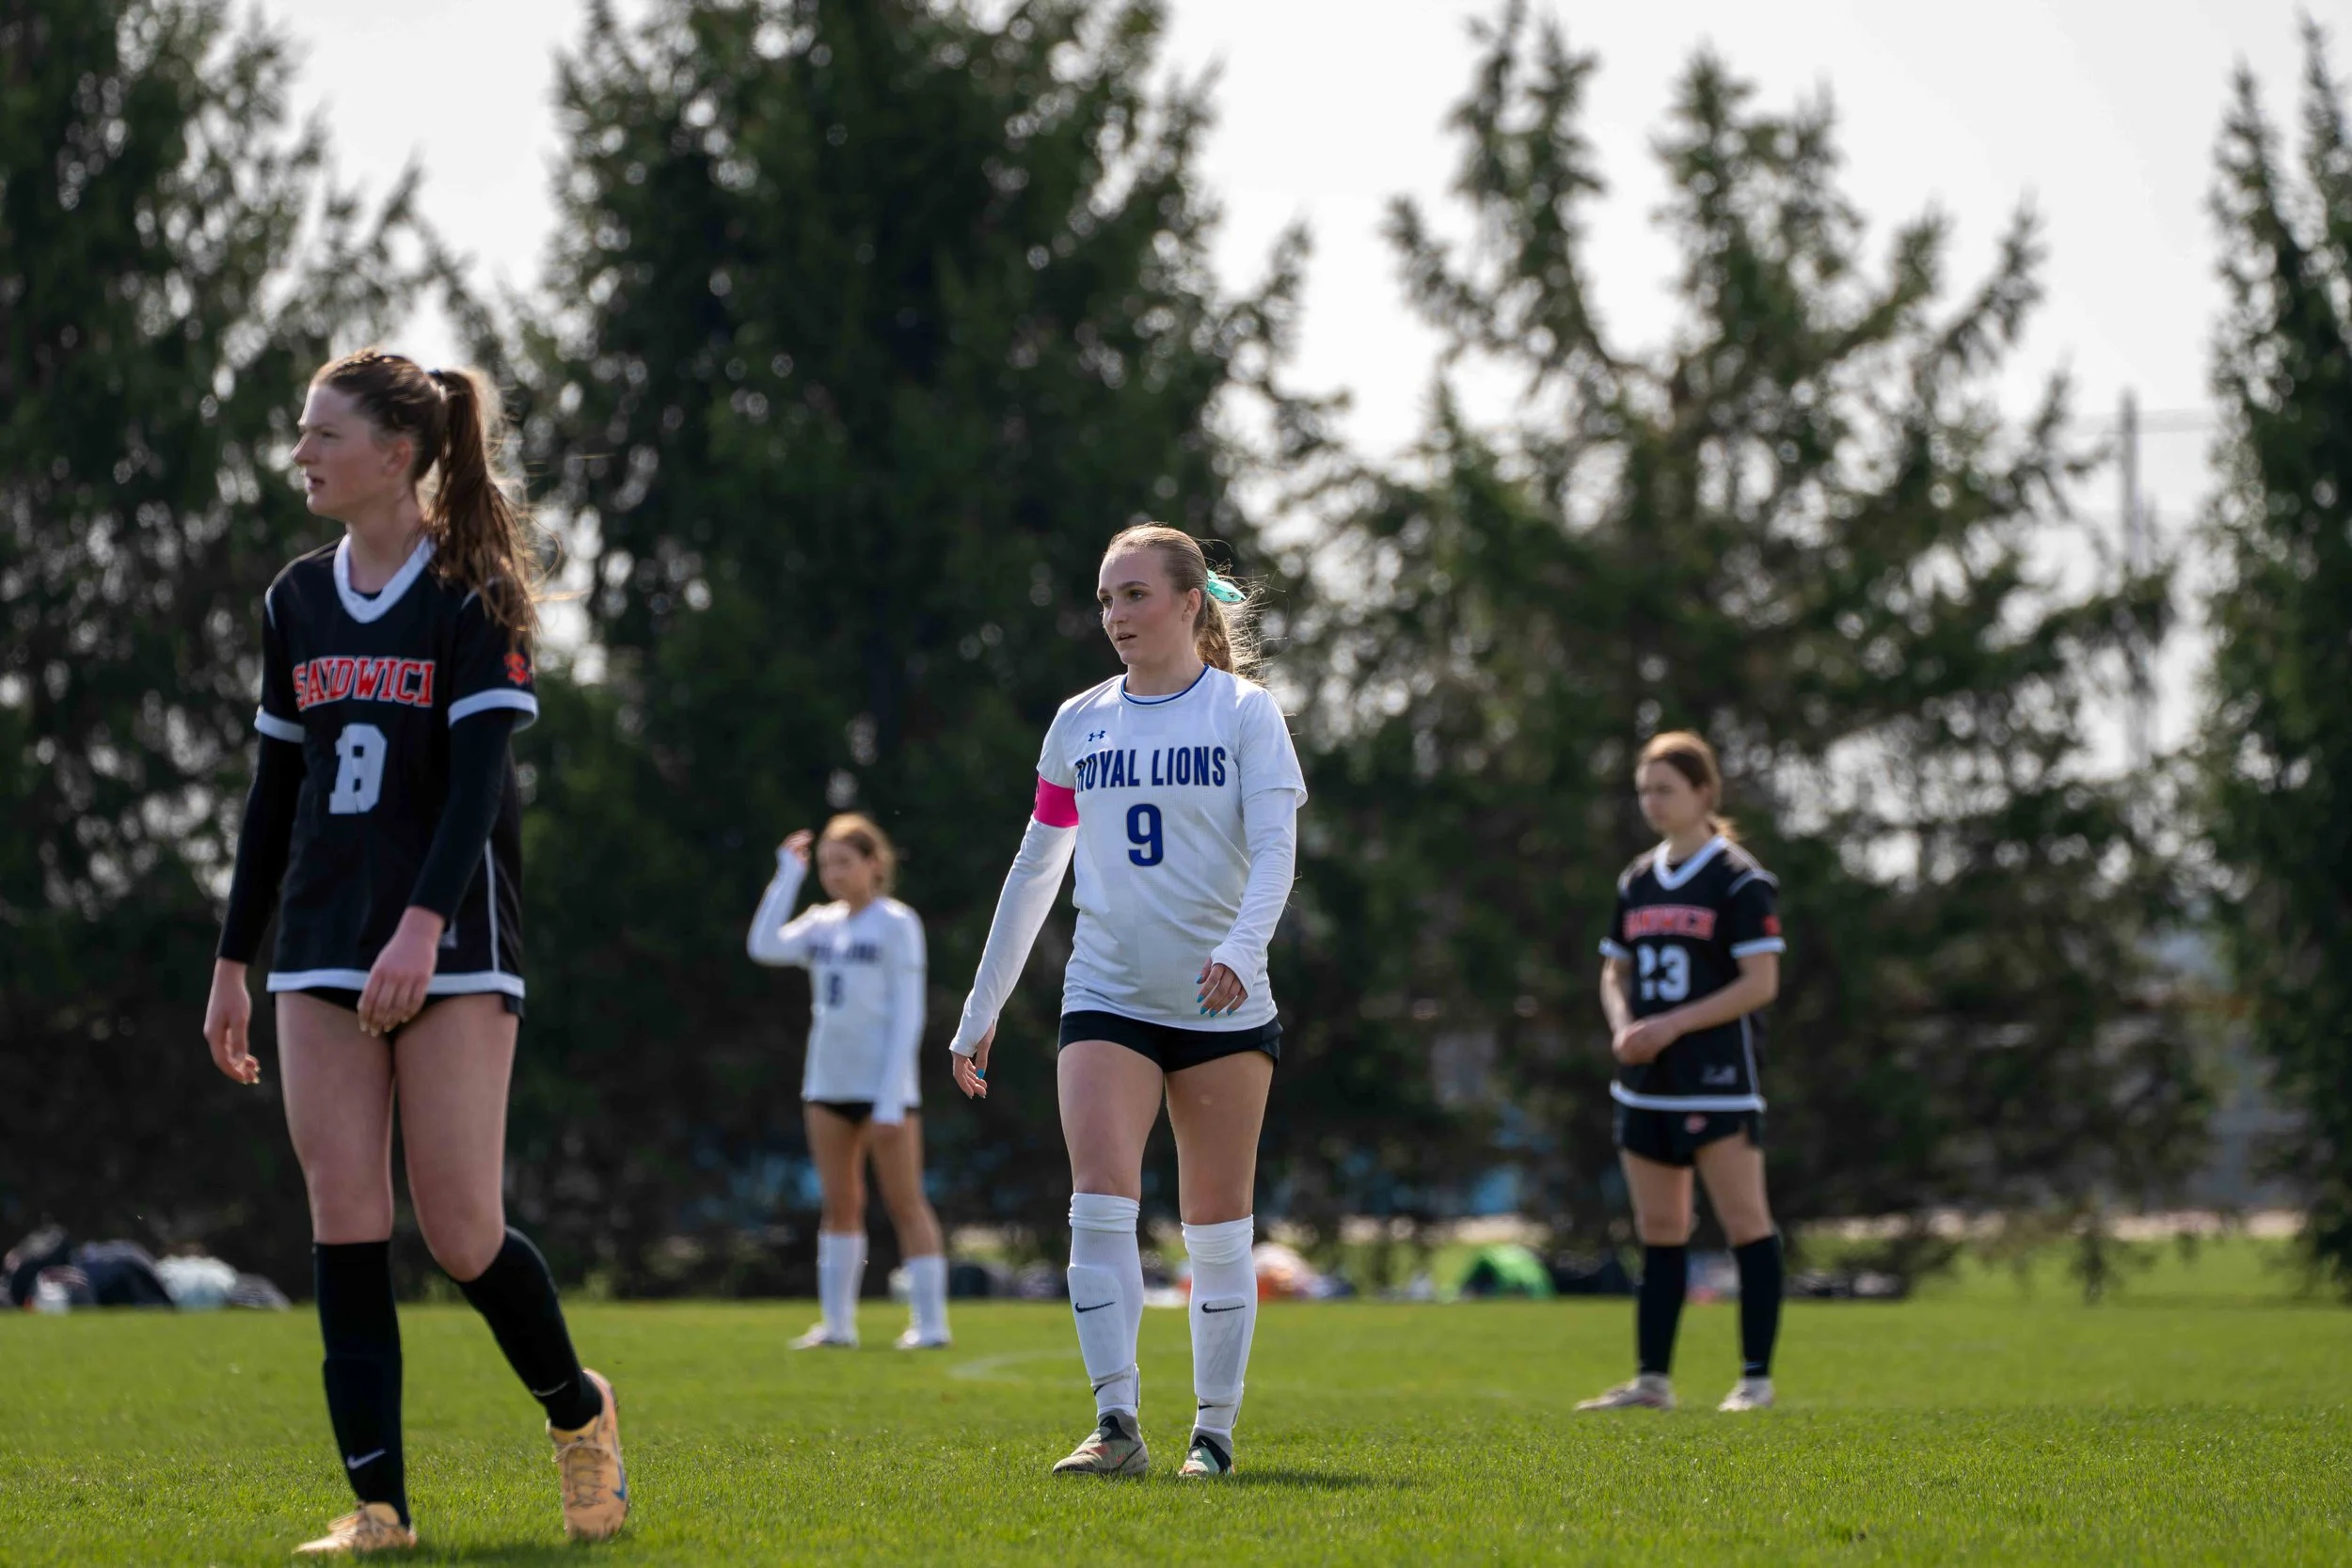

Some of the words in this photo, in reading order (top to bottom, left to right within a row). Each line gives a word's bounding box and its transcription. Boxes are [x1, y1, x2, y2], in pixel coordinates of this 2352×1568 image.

[1074, 749, 1140, 793] ROYAL
[1152, 746, 1227, 787] LIONS
[1126, 803, 1164, 867] 9
